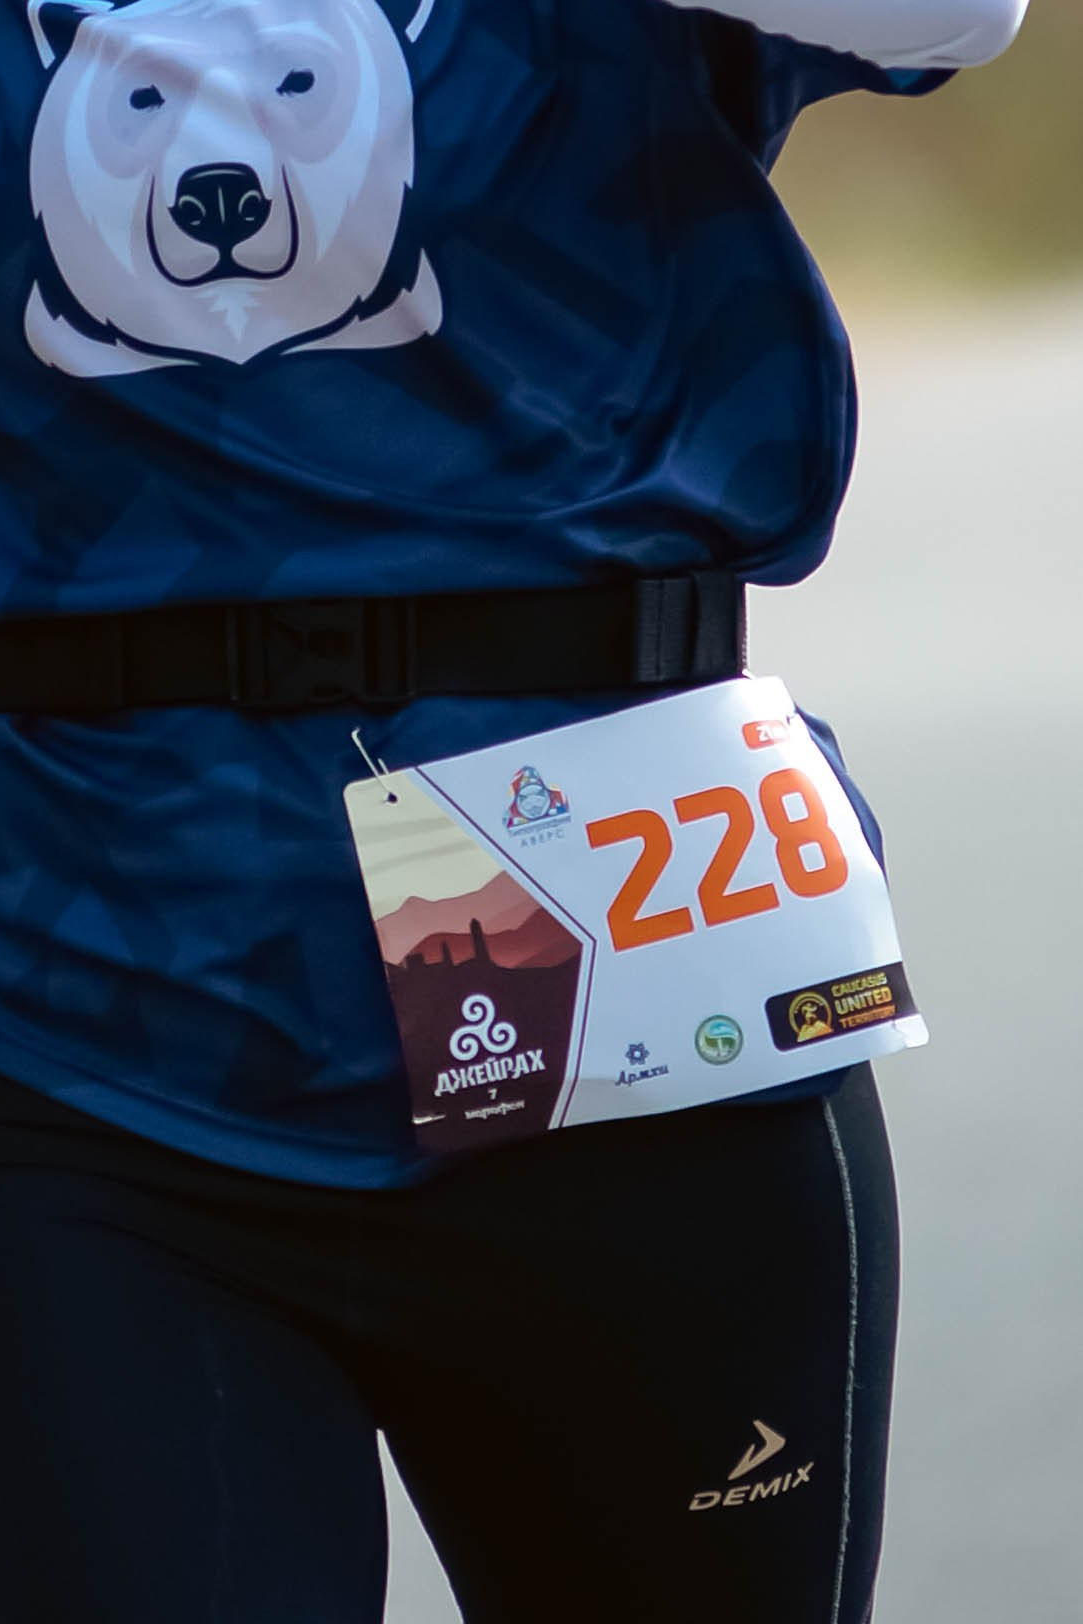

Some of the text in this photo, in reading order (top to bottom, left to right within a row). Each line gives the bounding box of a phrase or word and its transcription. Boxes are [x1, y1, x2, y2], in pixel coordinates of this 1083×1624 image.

[585, 767, 849, 953] 228
[835, 986, 892, 1015] UNITED
[434, 1049, 546, 1097] ДЖЕЙРАХ
[487, 1087, 498, 1100] 7
[688, 1461, 815, 1511] DEMIX
